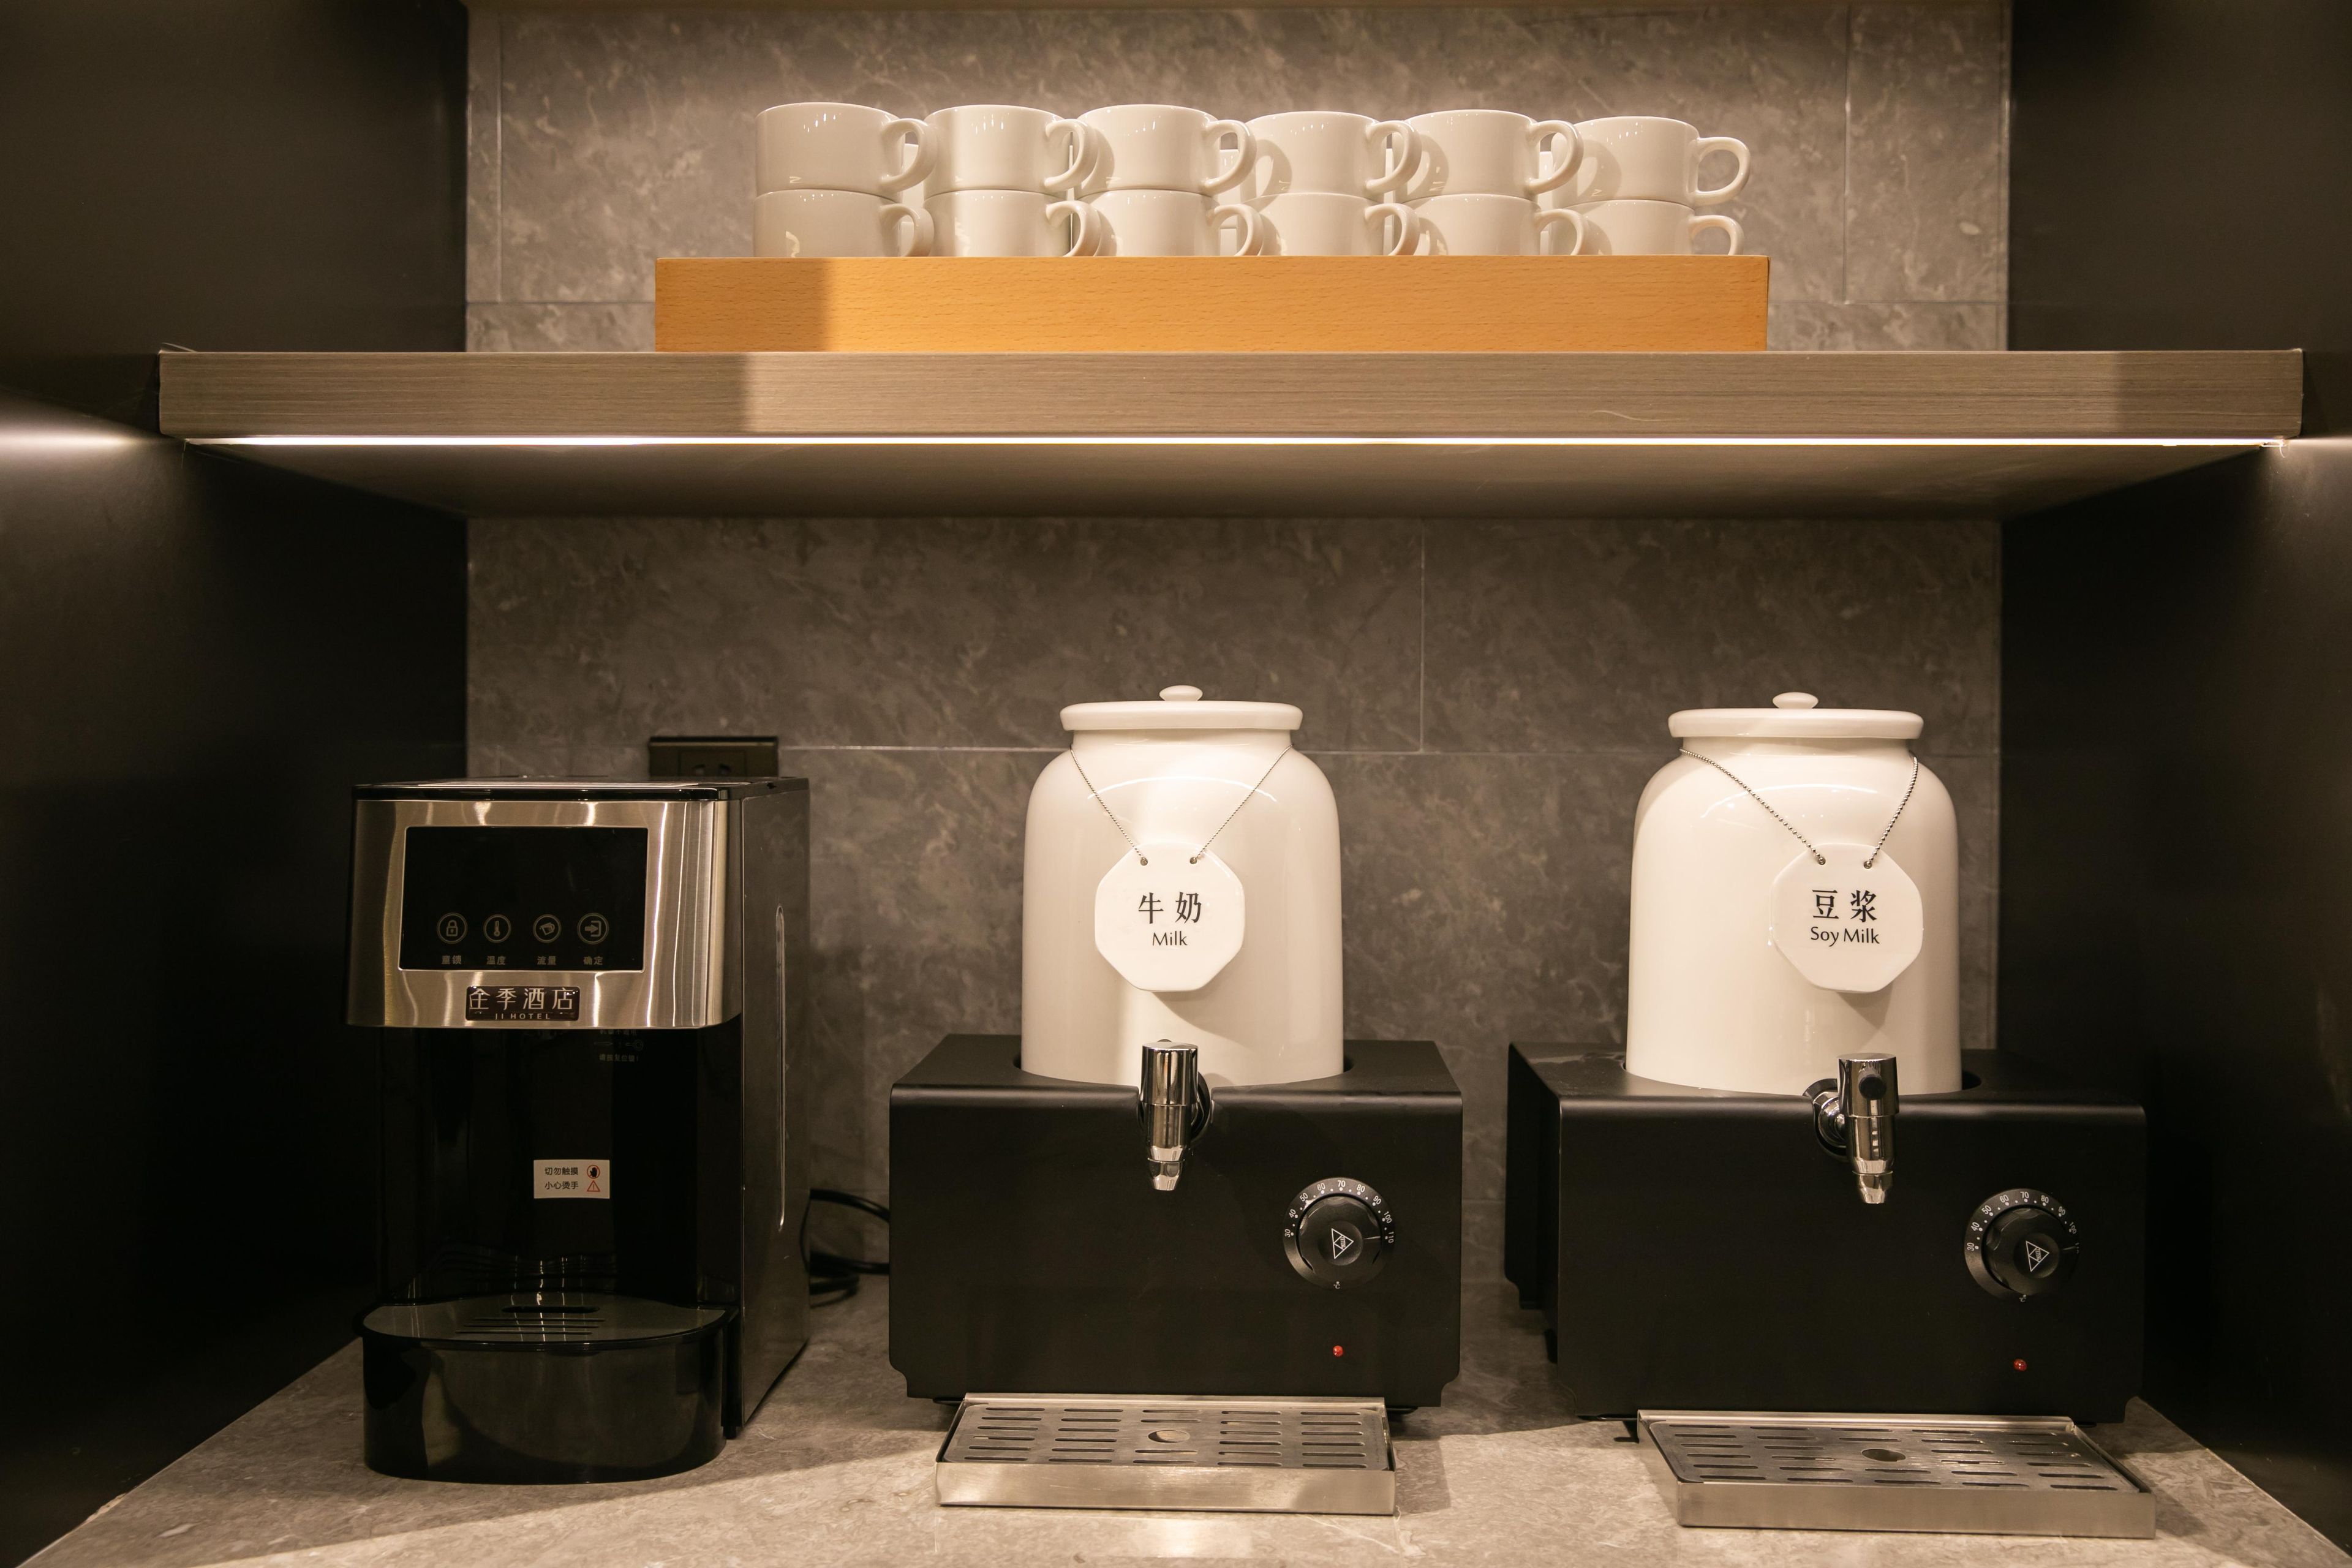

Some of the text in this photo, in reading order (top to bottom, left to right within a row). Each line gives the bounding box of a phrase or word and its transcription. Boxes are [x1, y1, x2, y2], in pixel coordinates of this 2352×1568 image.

[1138, 891, 1202, 924] 牛奶
[1812, 889, 1877, 923] 豆浆
[1152, 930, 1188, 946] Milk
[1811, 926, 1880, 947] Soy Milk
[441, 955, 462, 965] 童锁
[486, 956, 507, 965] 温度
[537, 956, 557, 965] 流量
[582, 956, 603, 965] 确定
[469, 987, 574, 1011] 全季酒店
[544, 1167, 579, 1176] 切勿触摸
[544, 1181, 579, 1190] 小心烫手
[1999, 1194, 2009, 1203] 60
[1284, 1229, 1291, 1238] 30
[1289, 1209, 1296, 1218] 40
[1300, 1193, 1308, 1202] 50
[1357, 1184, 1365, 1193] 80
[1373, 1196, 1382, 1205] 90
[1384, 1211, 1392, 1224] 100
[1981, 1205, 1992, 1215] 50
[2058, 1206, 2065, 1216] 90
[1970, 1222, 1980, 1231] 40
[1967, 1242, 1975, 1251] 30
